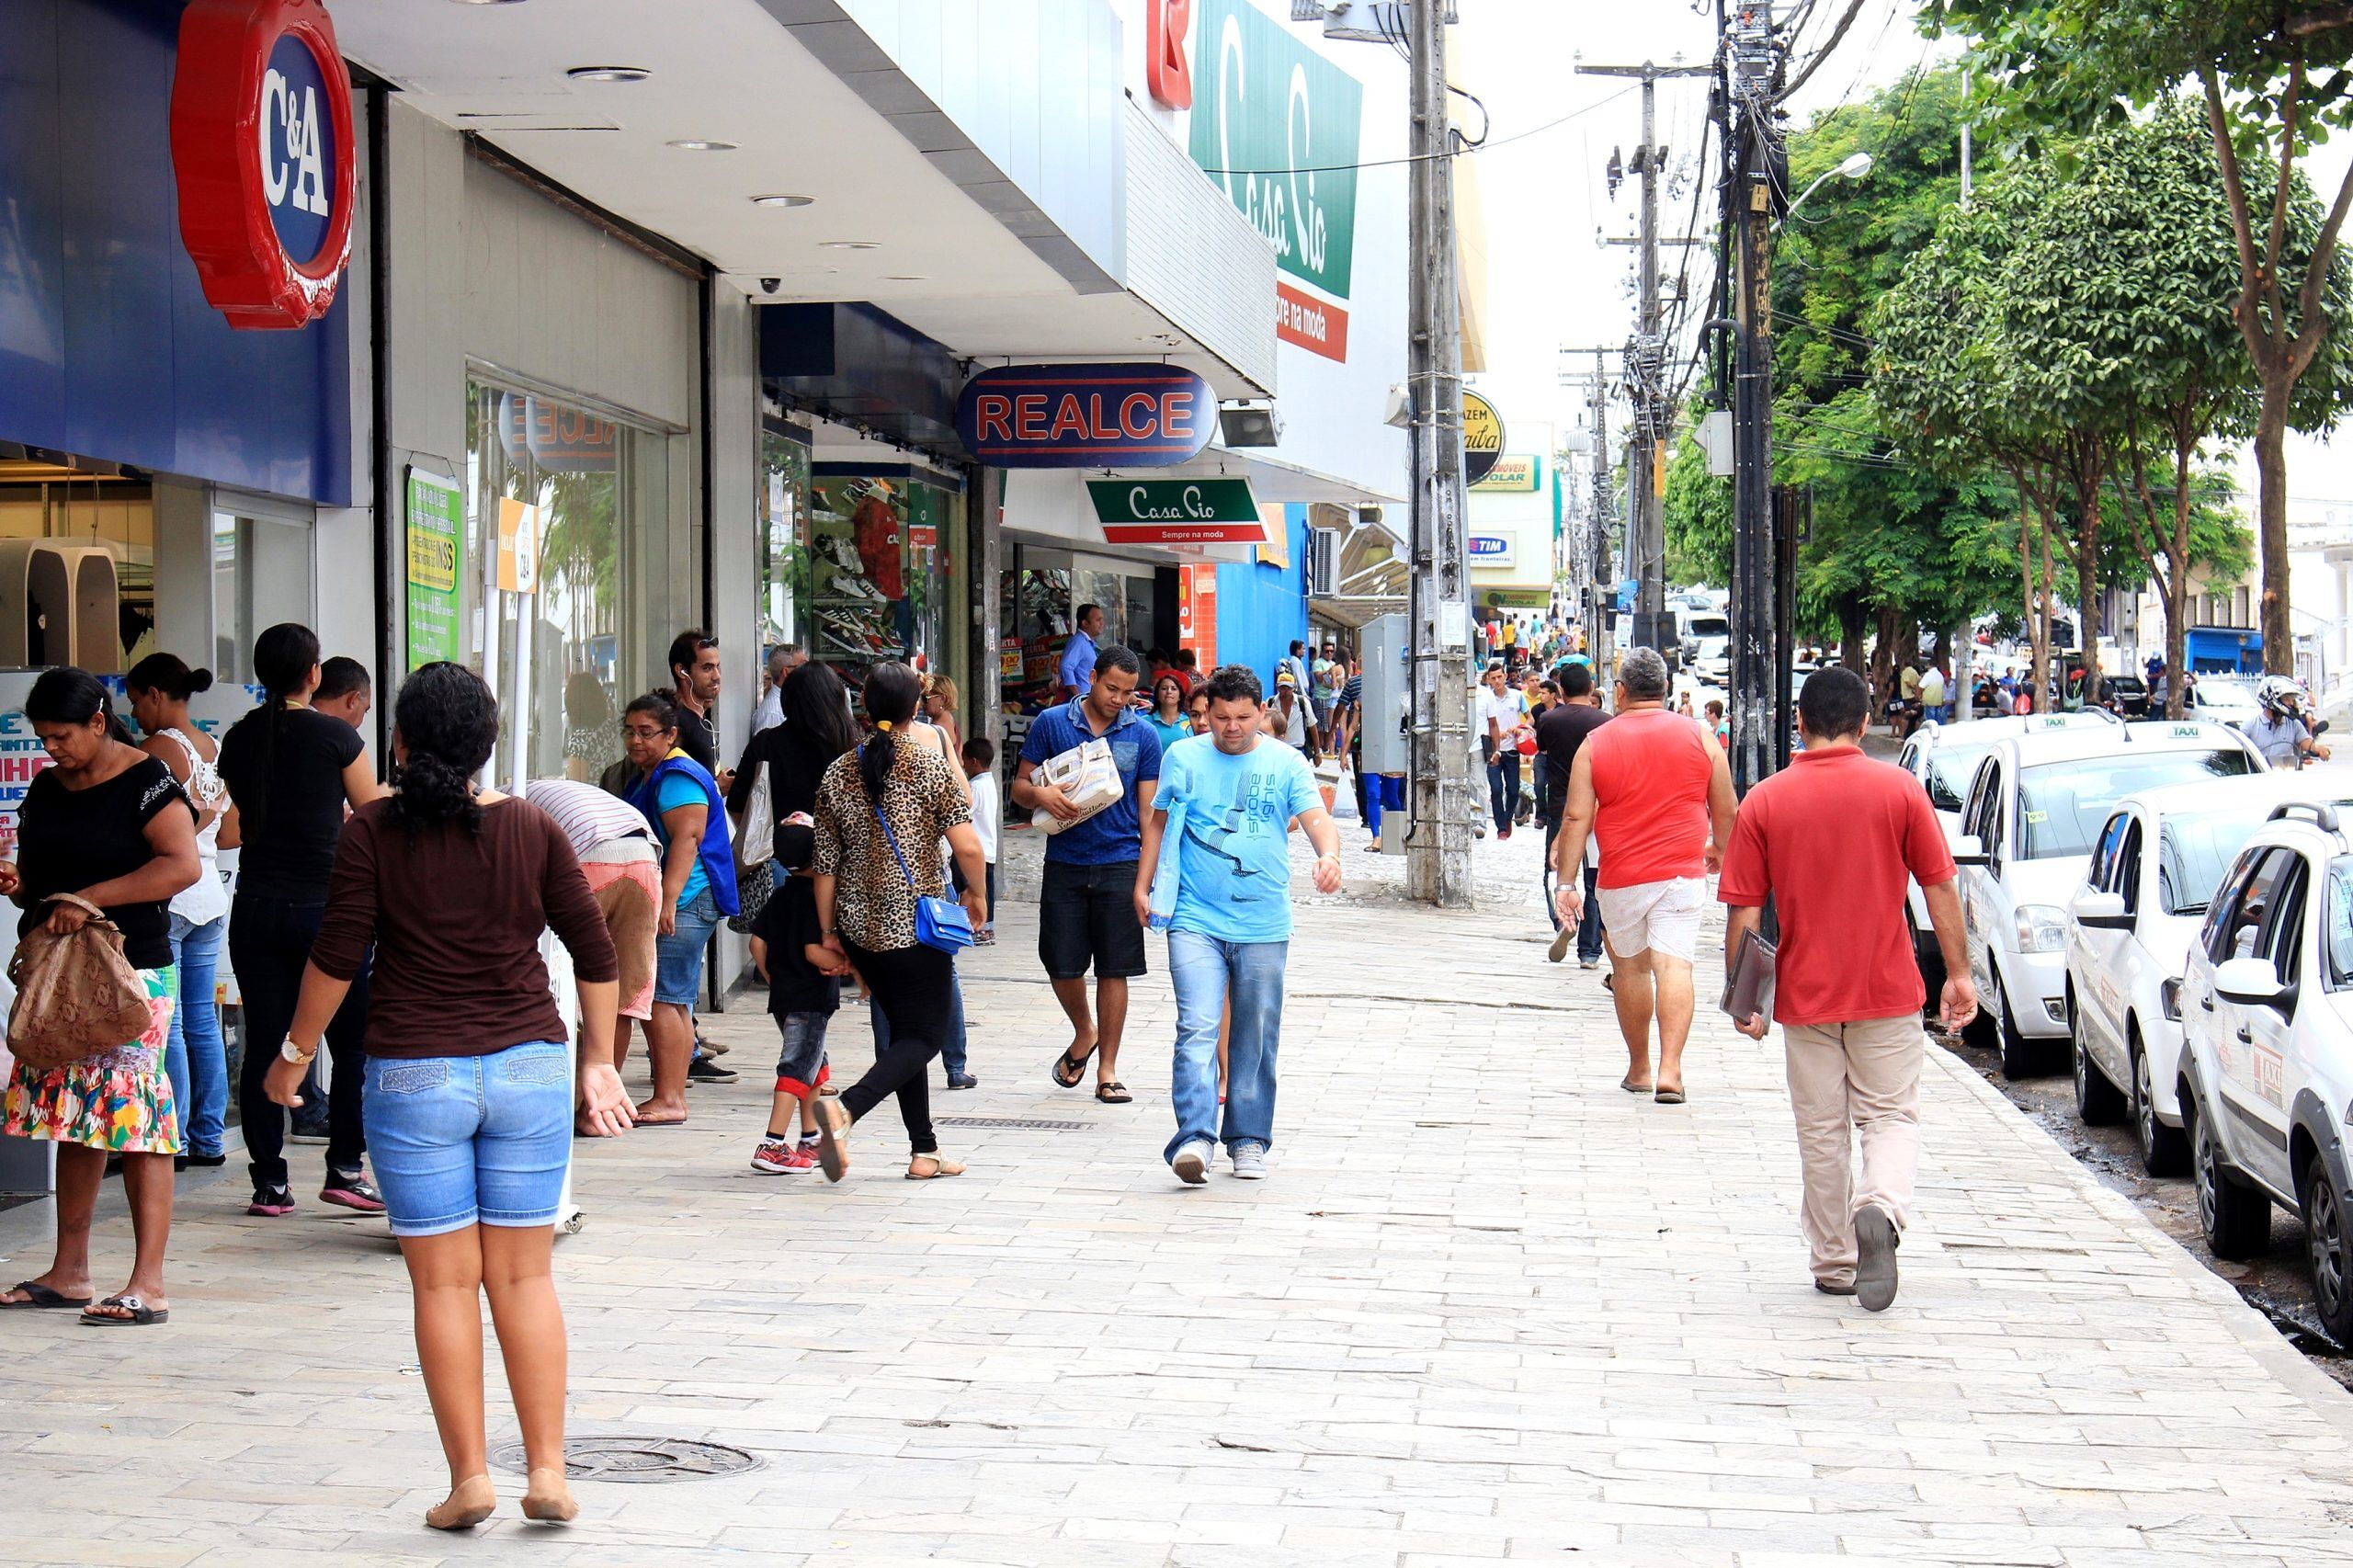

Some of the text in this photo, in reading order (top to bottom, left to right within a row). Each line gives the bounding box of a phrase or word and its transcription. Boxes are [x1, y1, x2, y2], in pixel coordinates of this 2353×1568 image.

[260, 68, 328, 217] C&A
[1290, 302, 1302, 333] na
[1302, 305, 1326, 343] moda
[977, 392, 1193, 441] REALCE
[1129, 486, 1183, 519] Casa
[1161, 530, 1190, 540] Sempre
[1202, 530, 1224, 539] moda
[1479, 540, 1502, 551] TIM
[437, 540, 453, 572] INSS
[2044, 718, 2066, 727] TAXI
[2173, 726, 2199, 736] TAXI
